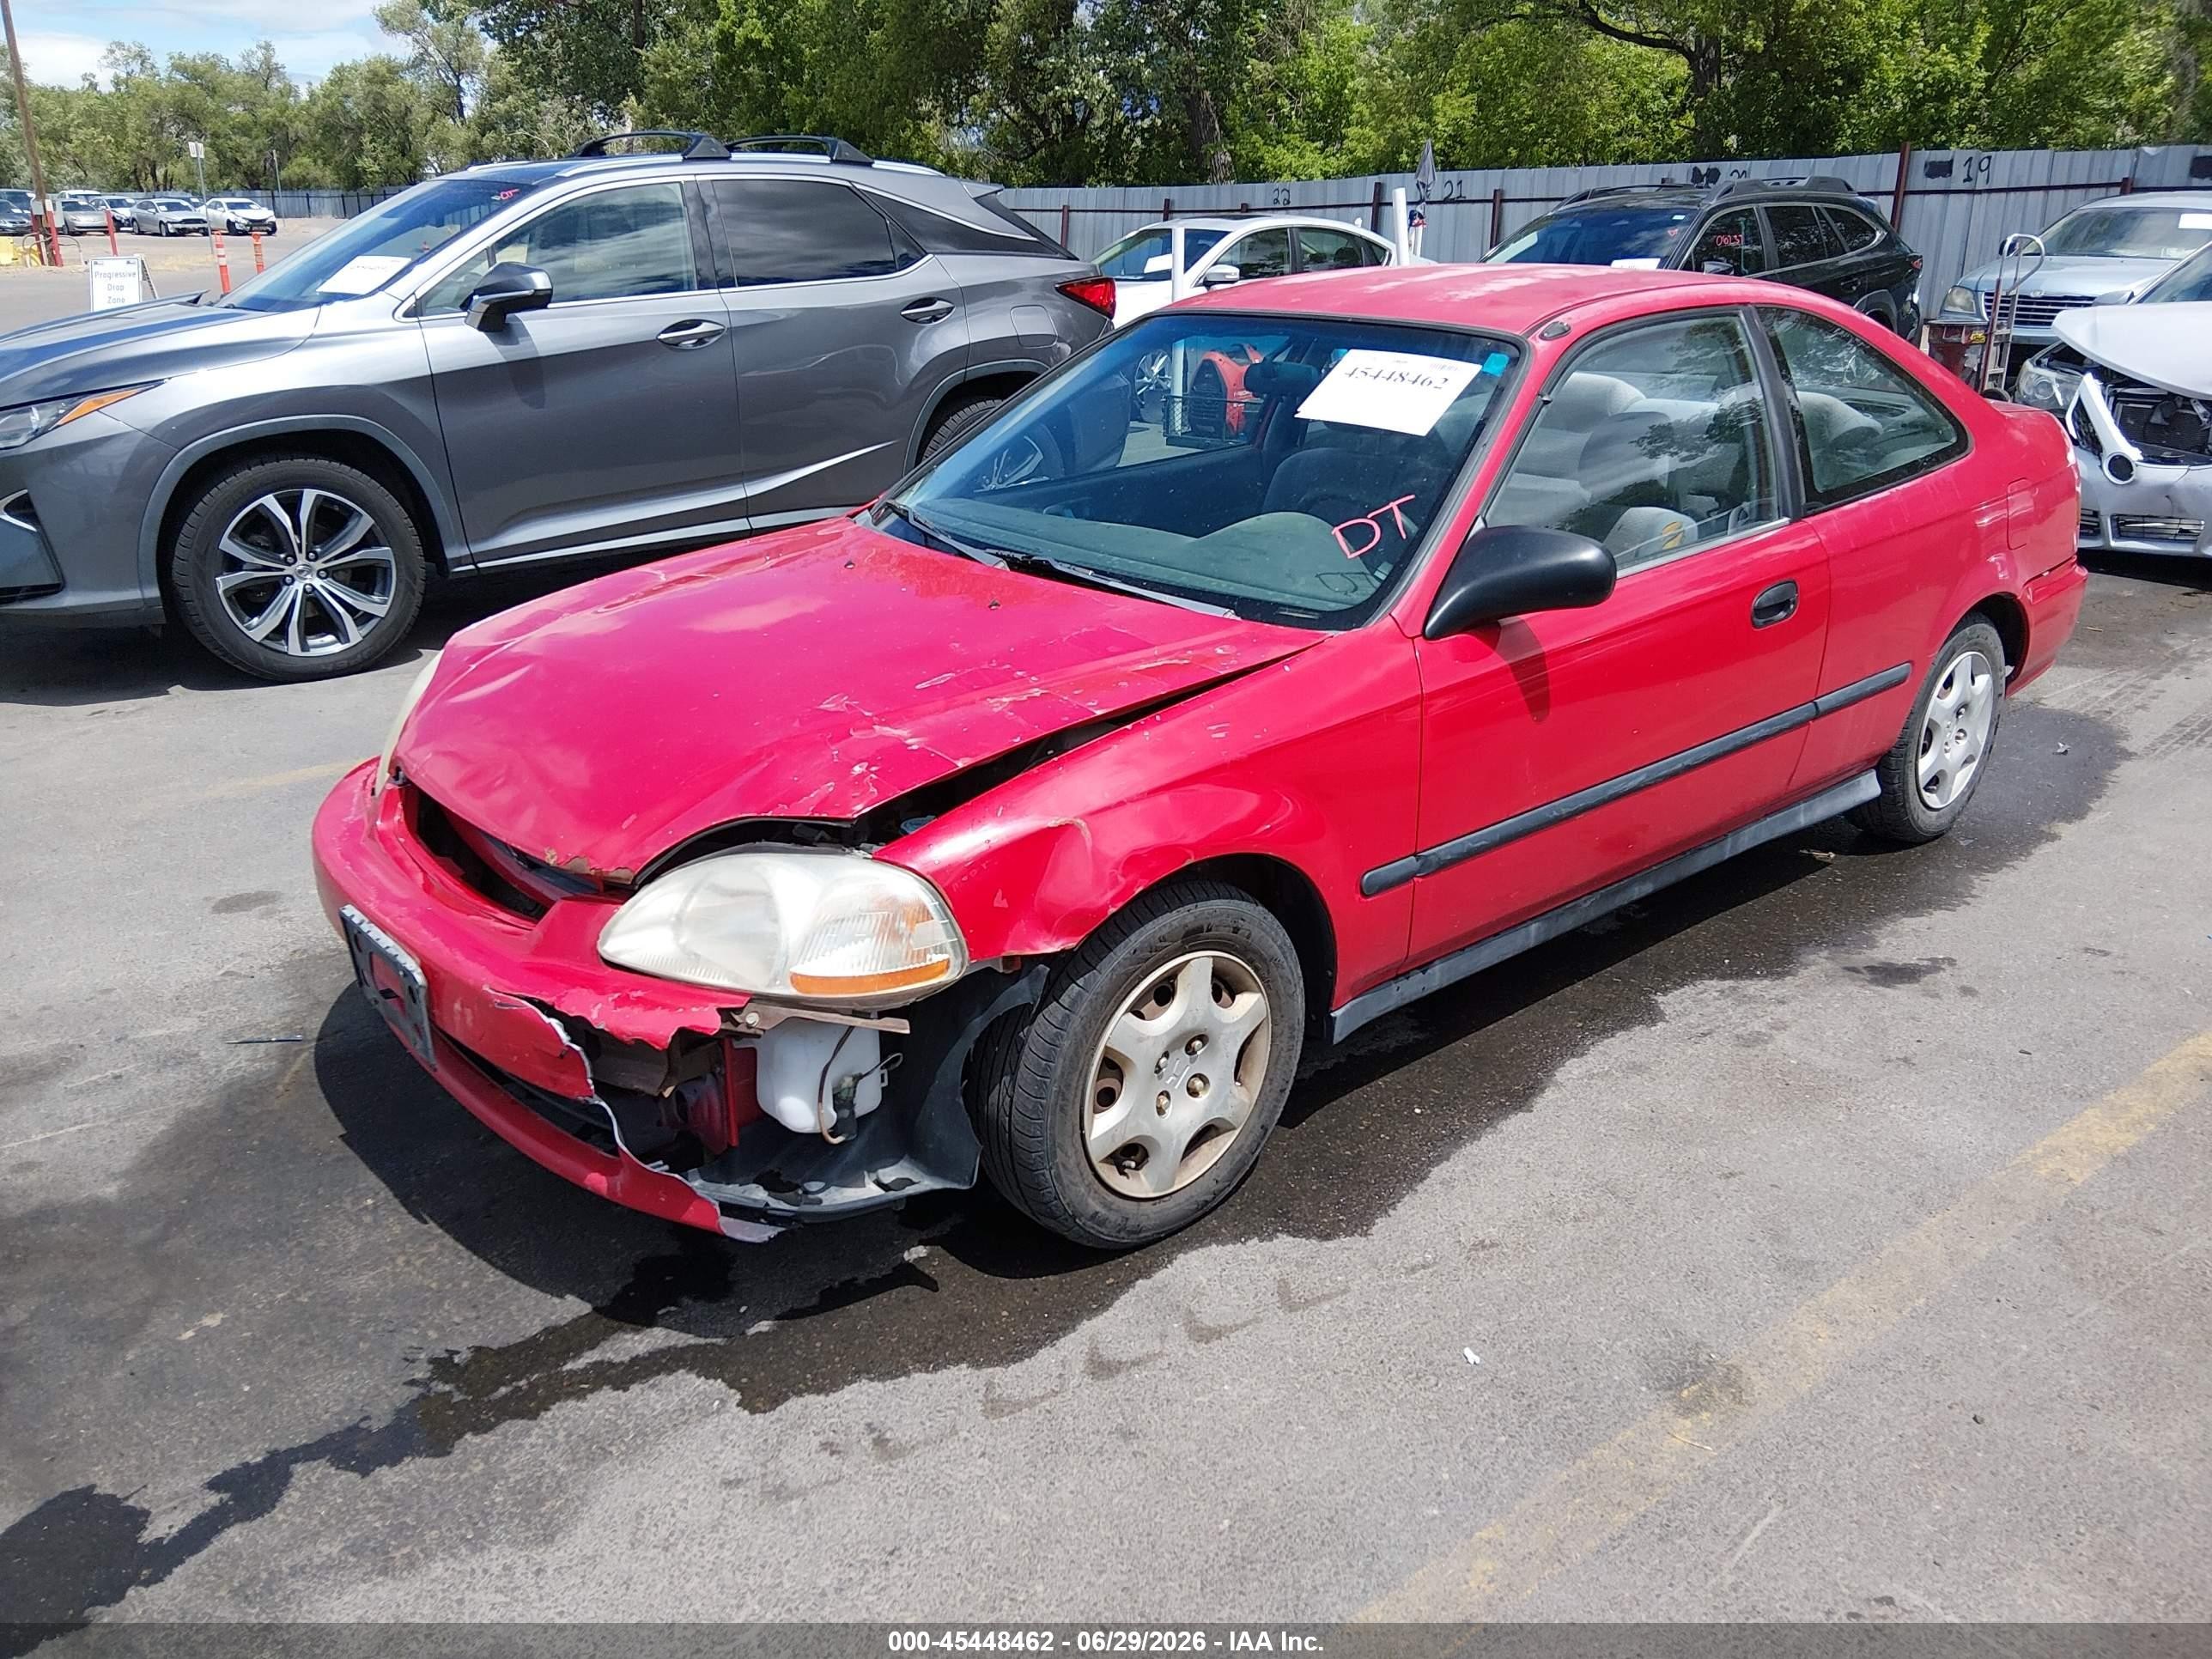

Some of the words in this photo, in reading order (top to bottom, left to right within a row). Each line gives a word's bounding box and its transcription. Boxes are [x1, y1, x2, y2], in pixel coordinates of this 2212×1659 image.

[1962, 155, 1992, 185] 19
[1273, 188, 1291, 205] 22
[1443, 180, 1467, 202] 21
[94, 271, 137, 281] Progressive
[1332, 495, 1415, 559] DT
